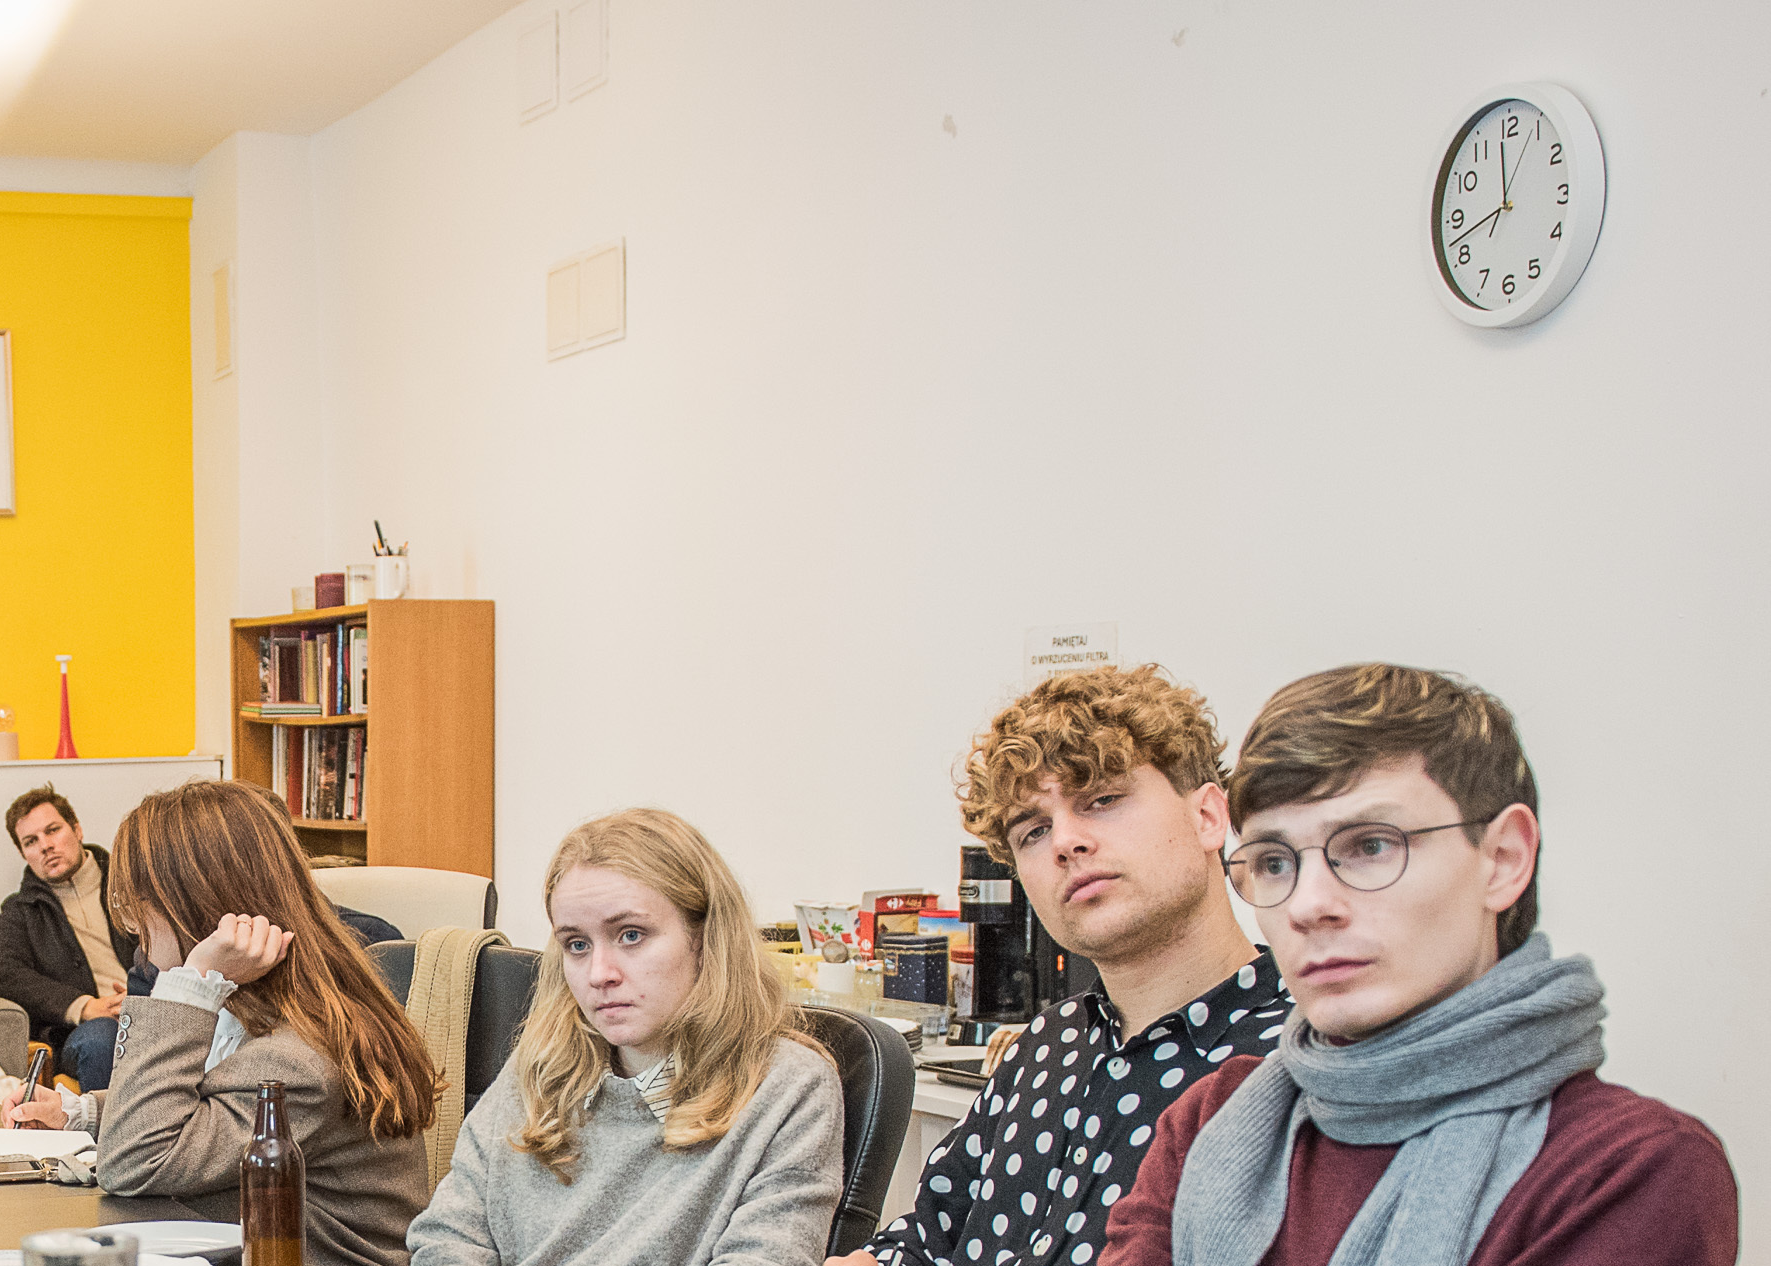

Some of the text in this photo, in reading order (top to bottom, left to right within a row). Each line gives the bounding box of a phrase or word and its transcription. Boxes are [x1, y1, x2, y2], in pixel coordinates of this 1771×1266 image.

[1501, 115, 1519, 140] 12
[1536, 119, 1540, 141] 1
[1474, 140, 1488, 163] 11
[1549, 142, 1563, 166] 2
[1458, 170, 1478, 194] 10
[1556, 183, 1569, 205] 3
[1451, 209, 1465, 230] 9
[1549, 221, 1562, 241] 4
[1457, 244, 1471, 265] 8
[1478, 268, 1490, 289] 7
[1527, 258, 1541, 279] 5
[1501, 274, 1515, 295] 6
[1052, 635, 1088, 648] PAMIĘTAJ
[1086, 651, 1109, 662] FILTRA
